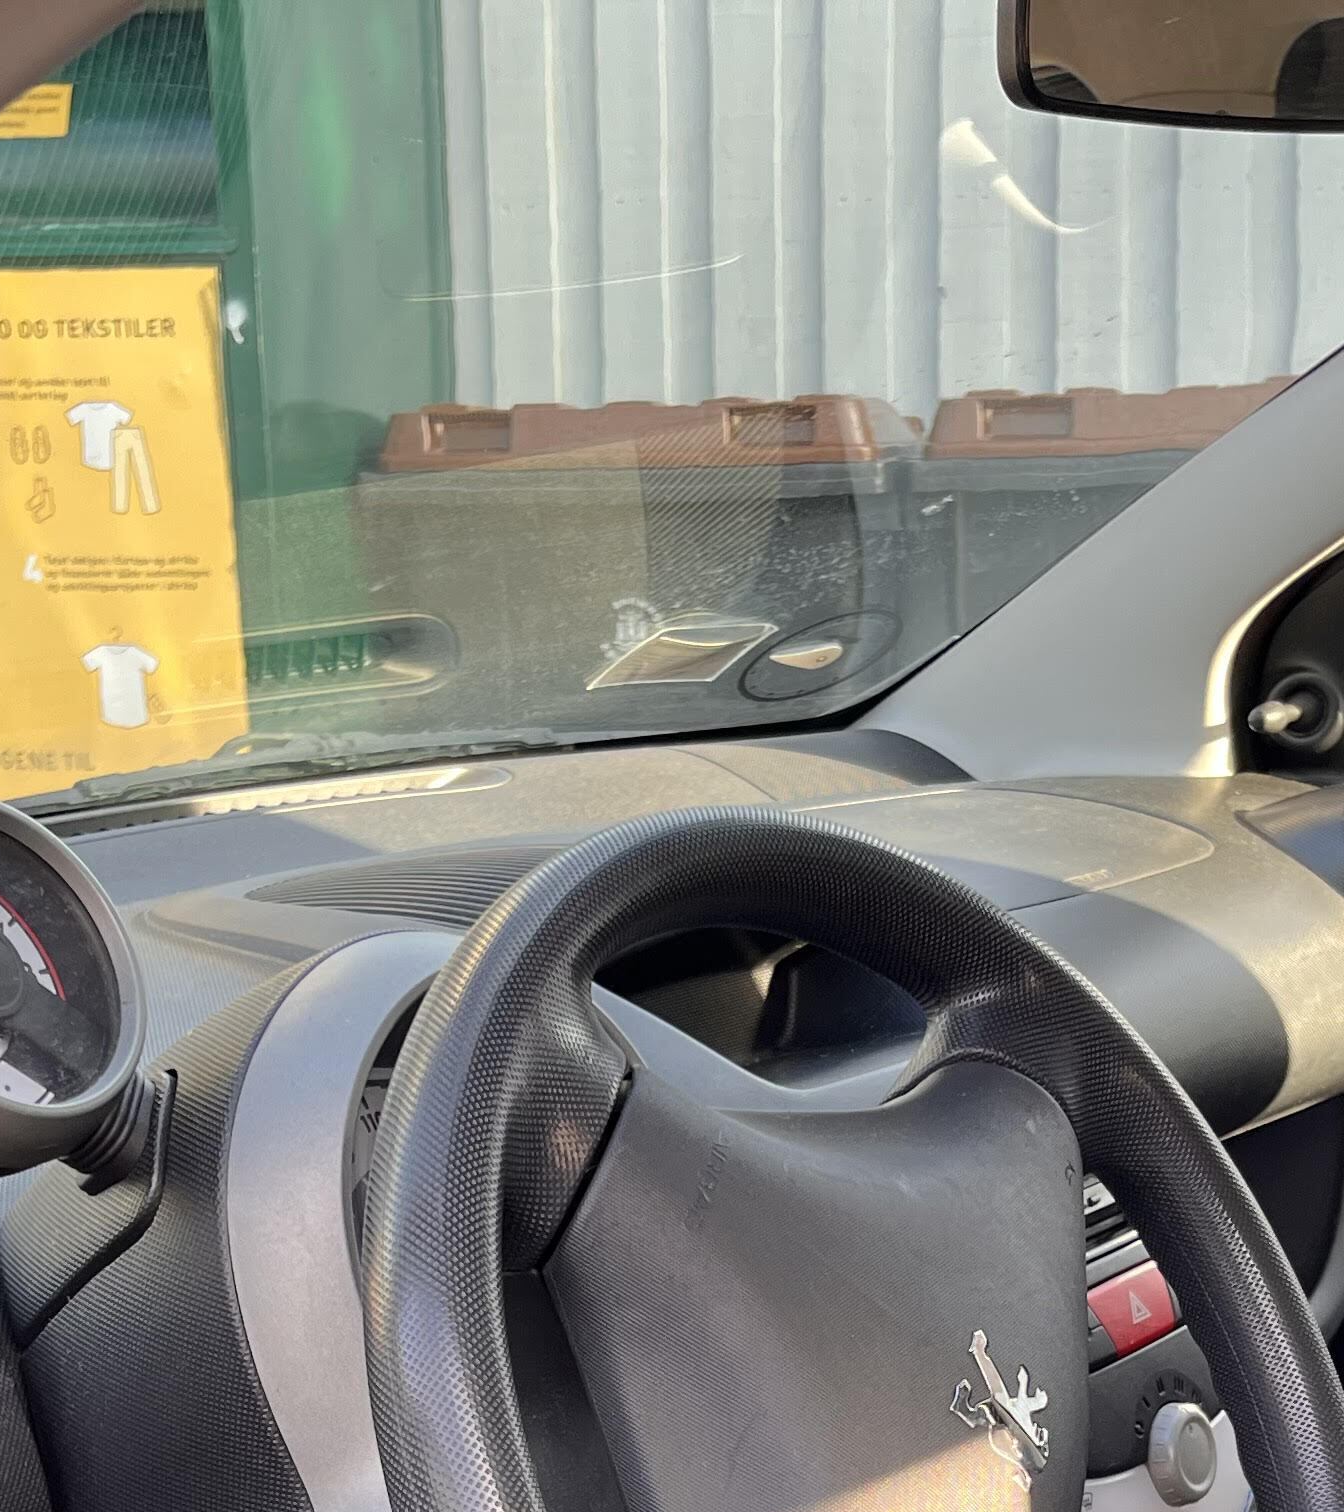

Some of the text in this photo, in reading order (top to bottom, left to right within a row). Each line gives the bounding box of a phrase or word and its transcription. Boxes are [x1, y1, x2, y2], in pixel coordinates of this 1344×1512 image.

[17, 318, 48, 339] OG
[54, 317, 176, 338] TEKSTILER
[61, 751, 95, 771] TIL
